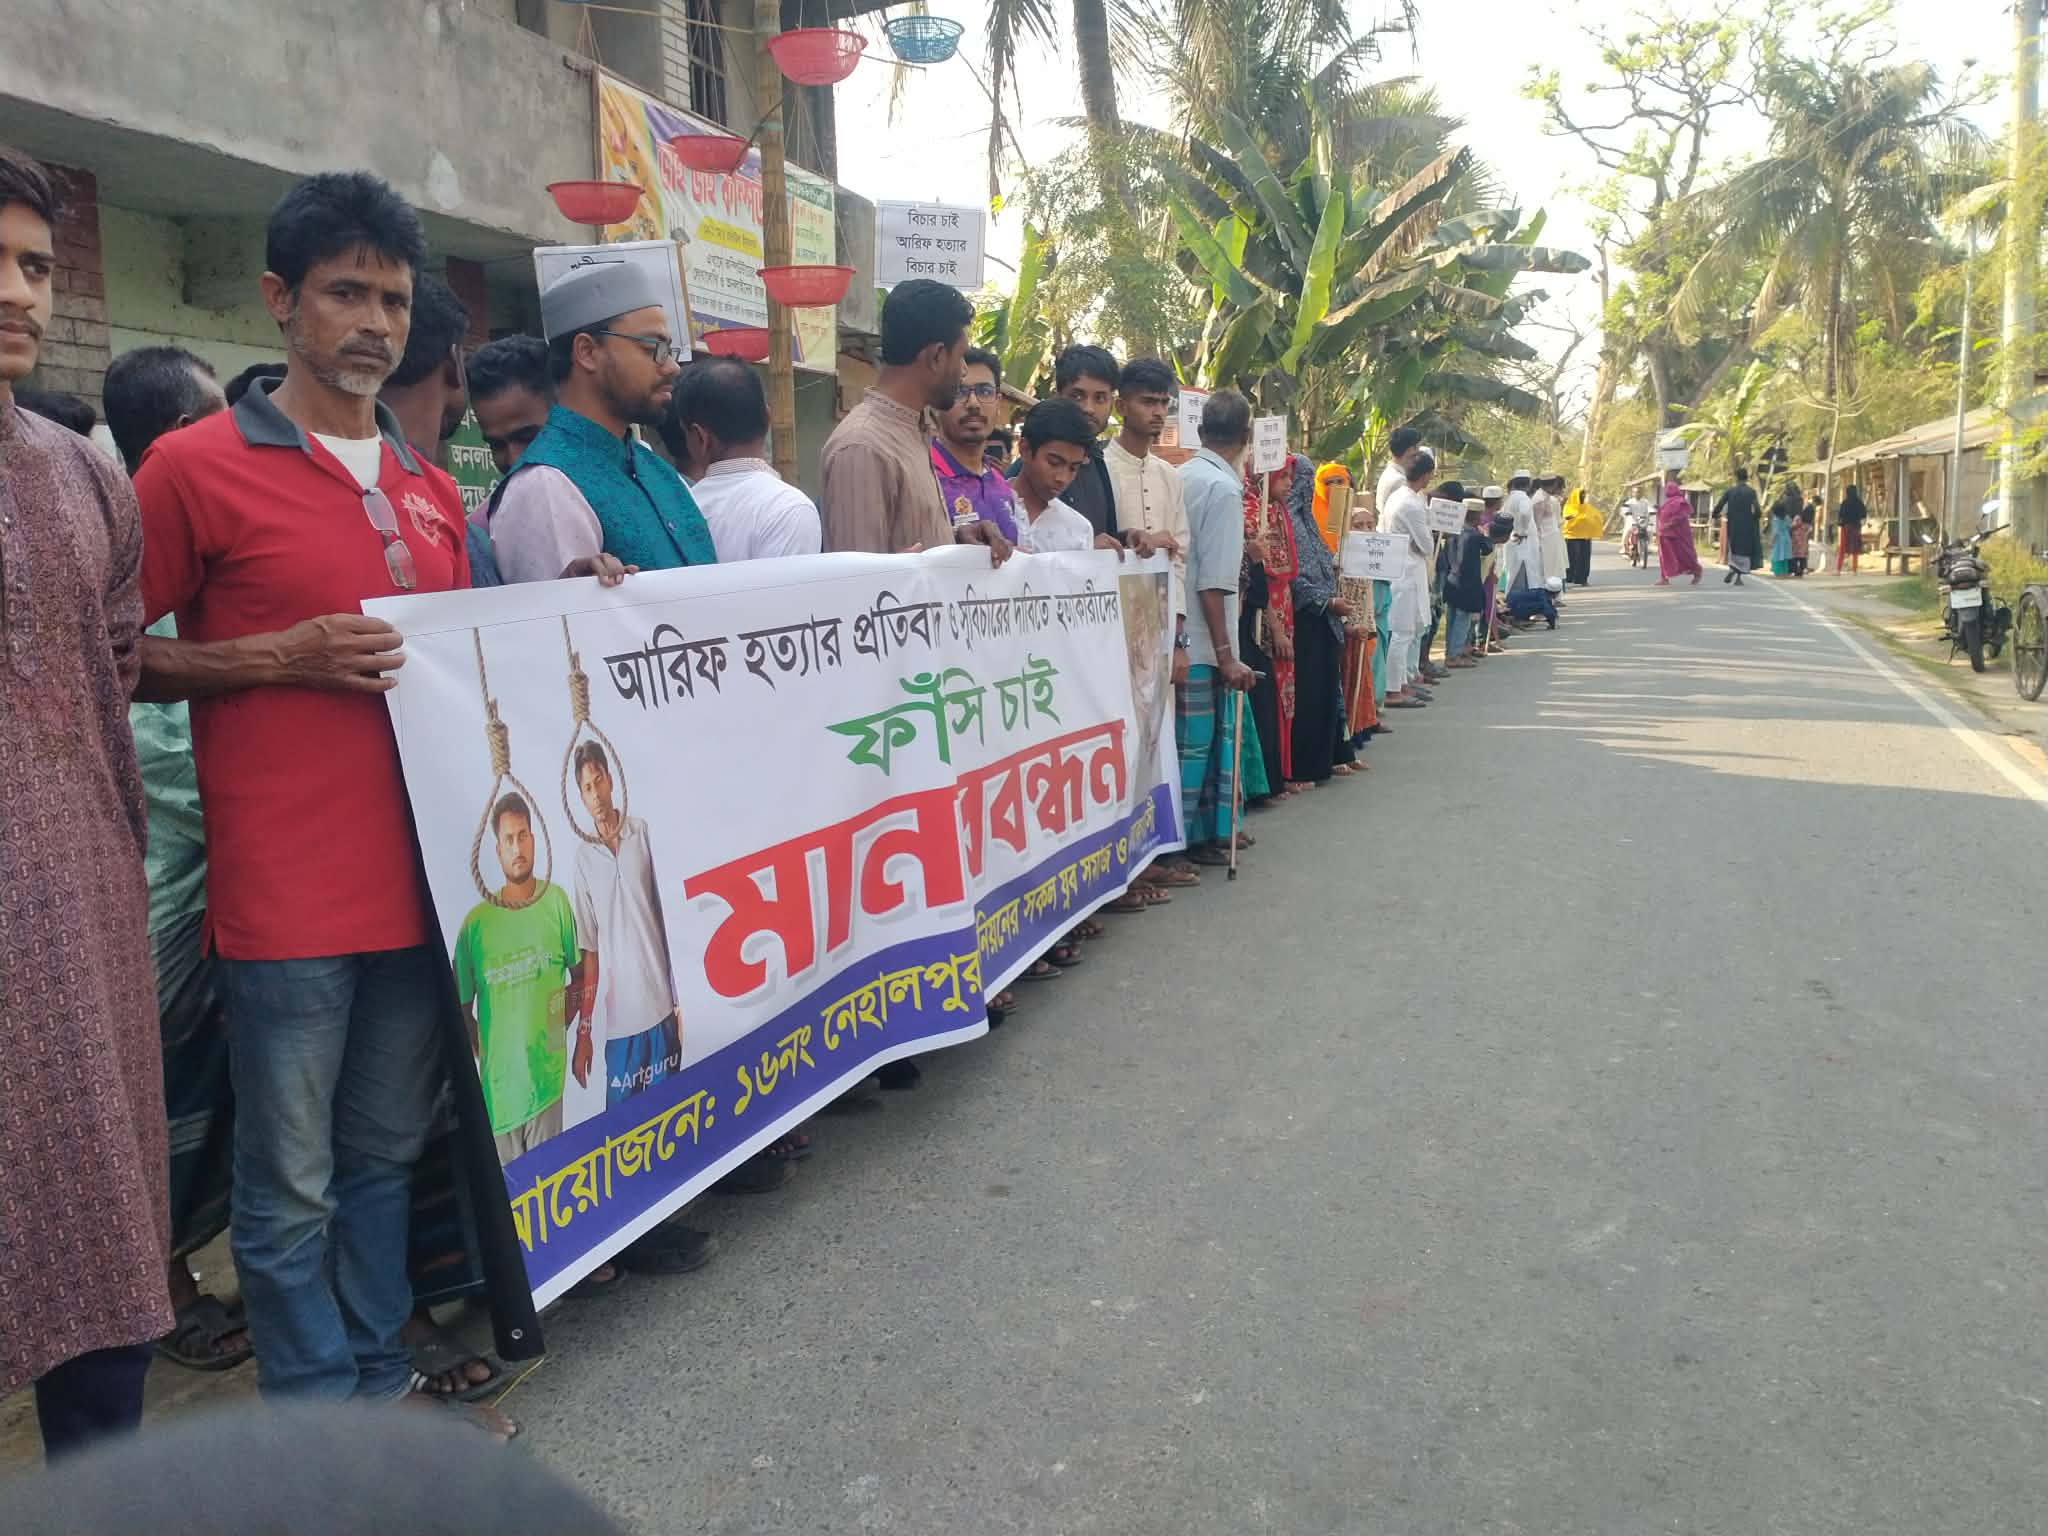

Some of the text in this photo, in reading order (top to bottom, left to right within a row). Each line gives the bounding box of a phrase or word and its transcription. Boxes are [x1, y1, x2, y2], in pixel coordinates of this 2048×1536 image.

[908, 208, 961, 229] বিচার চাই
[895, 233, 969, 253] আরিফ হত্যার
[905, 256, 958, 276] বিচার চাই
[603, 622, 729, 711] আরিফ
[736, 613, 843, 693] হত্যার
[824, 652, 1062, 777] ফাঁসি চাই
[734, 1024, 815, 1116] ১৬নং
[821, 949, 983, 1051] নেহালপুর
[1024, 875, 1058, 924] সকল
[1058, 863, 1079, 912] যুব
[1080, 841, 1114, 889] সমাজ
[1116, 836, 1128, 865] ও
[620, 1052, 679, 1094] Artguru
